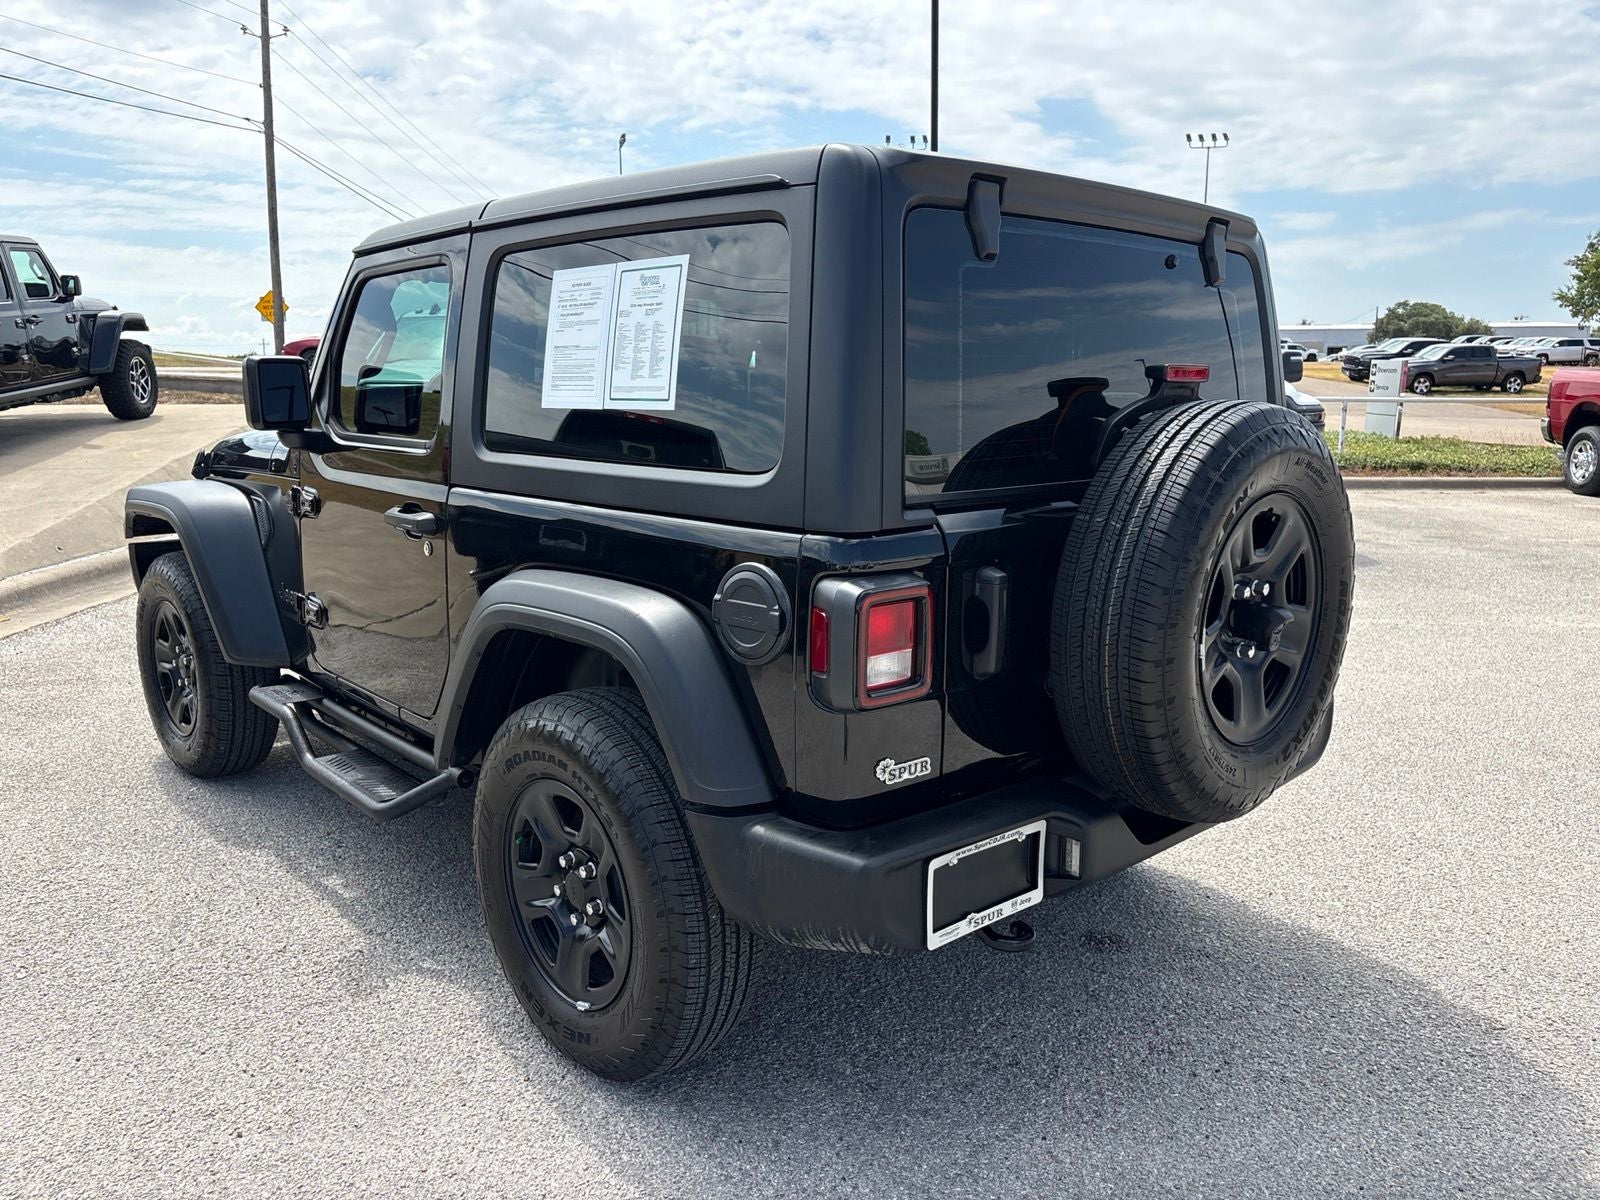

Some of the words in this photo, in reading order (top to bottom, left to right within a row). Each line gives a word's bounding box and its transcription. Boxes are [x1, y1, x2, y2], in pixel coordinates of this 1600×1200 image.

[1377, 366, 1398, 374] Showroom
[1294, 457, 1329, 485] All-Weather
[1315, 579, 1350, 703] ROADIAN
[504, 750, 569, 774] ROADIAN
[888, 760, 930, 782] SPUR
[1208, 746, 1237, 777] 245/75R17
[955, 830, 1021, 858] www.SpurCDJR.com
[1018, 897, 1032, 906] Jeep
[973, 908, 1004, 928] SPUR
[520, 981, 592, 1045] NEXEN
